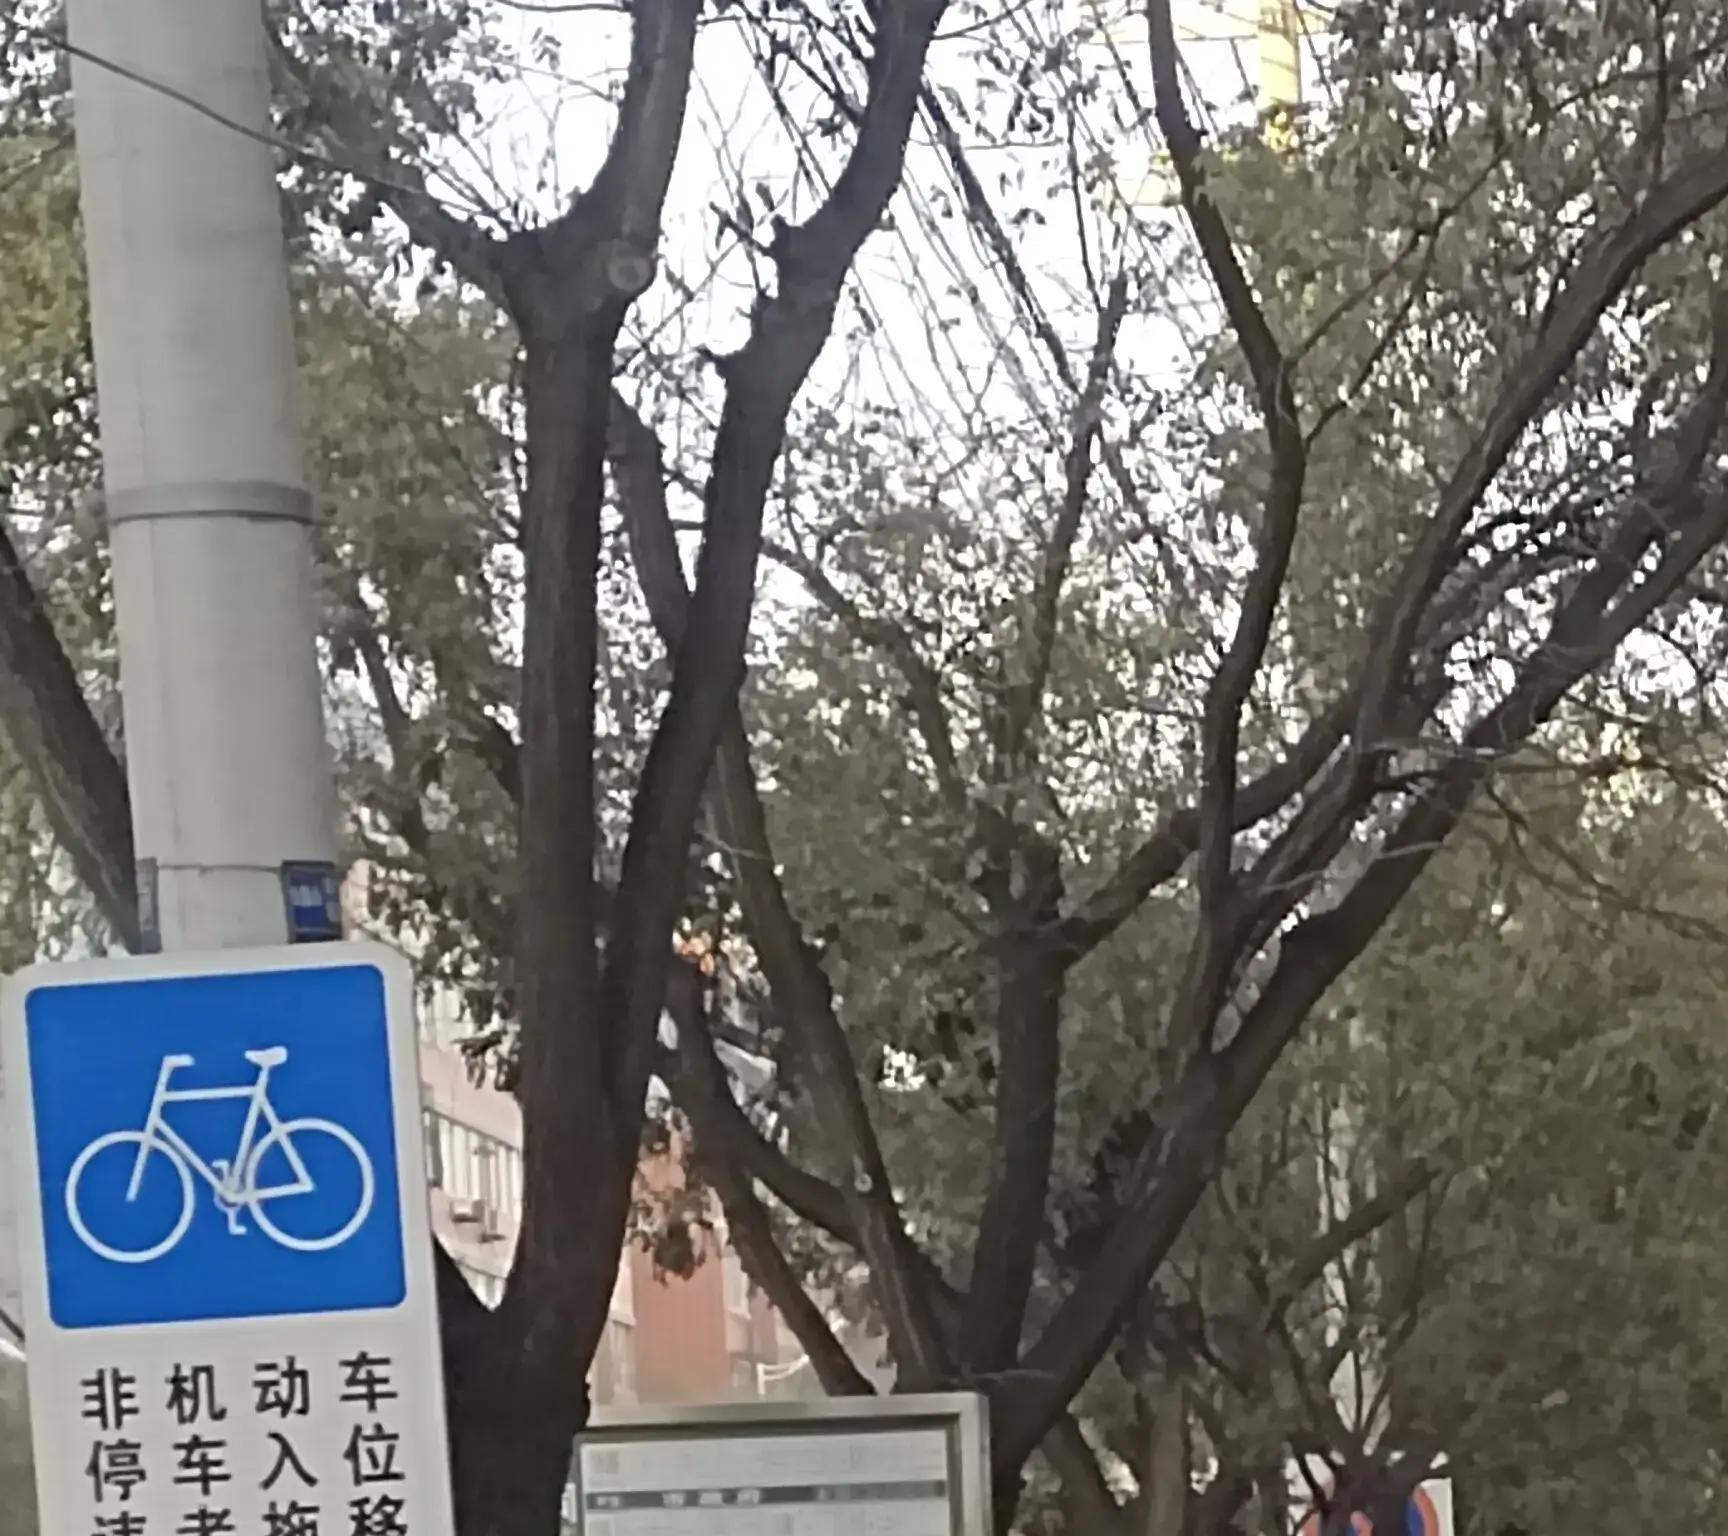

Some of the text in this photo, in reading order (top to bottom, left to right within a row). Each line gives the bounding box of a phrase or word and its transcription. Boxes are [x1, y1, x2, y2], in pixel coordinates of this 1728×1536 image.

[81, 1351, 399, 1430] 非机动车
[85, 1425, 406, 1503] 停车入位
